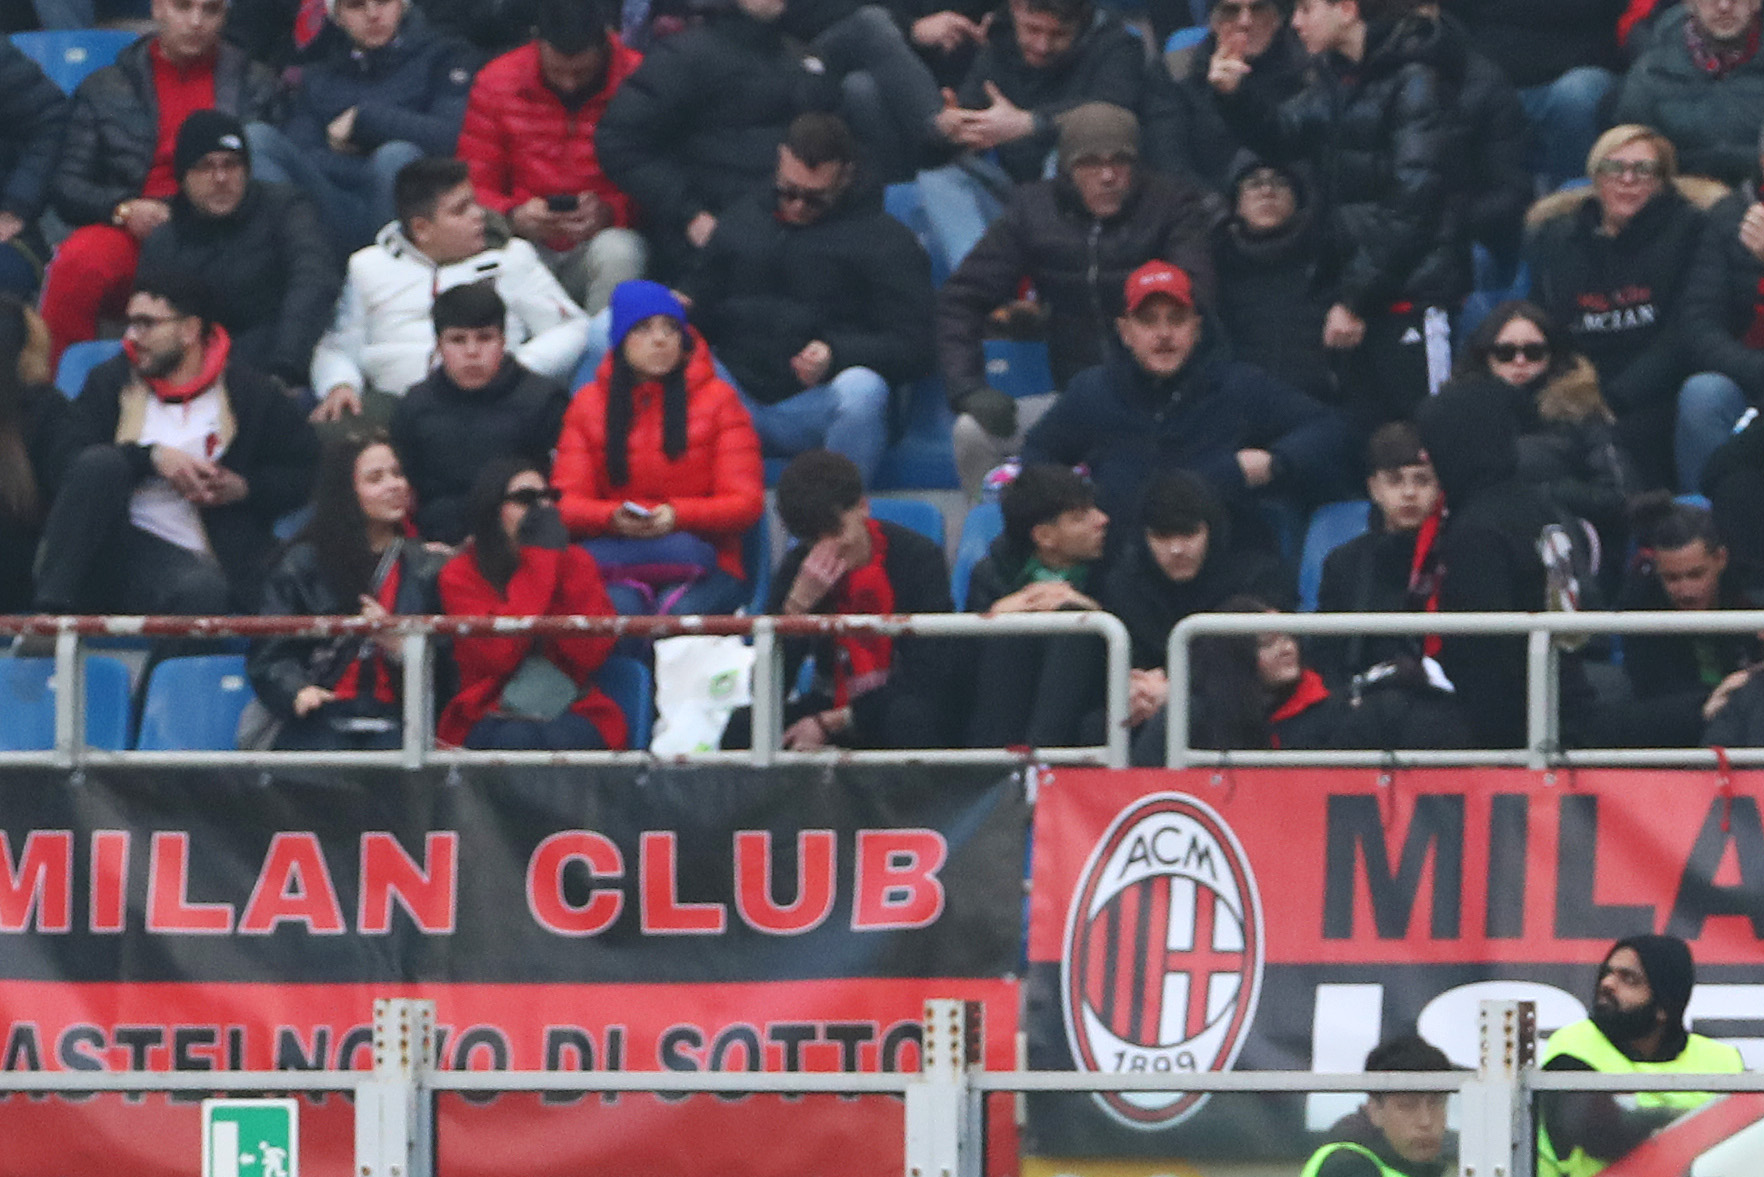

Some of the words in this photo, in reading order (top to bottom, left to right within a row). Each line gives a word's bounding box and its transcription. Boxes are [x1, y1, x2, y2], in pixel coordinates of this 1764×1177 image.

[0, 829, 458, 935] MILAN
[526, 827, 948, 937] CLUB
[1116, 826, 1218, 881] ACM
[541, 1023, 627, 1106] DI
[1113, 1051, 1196, 1072] 1899
